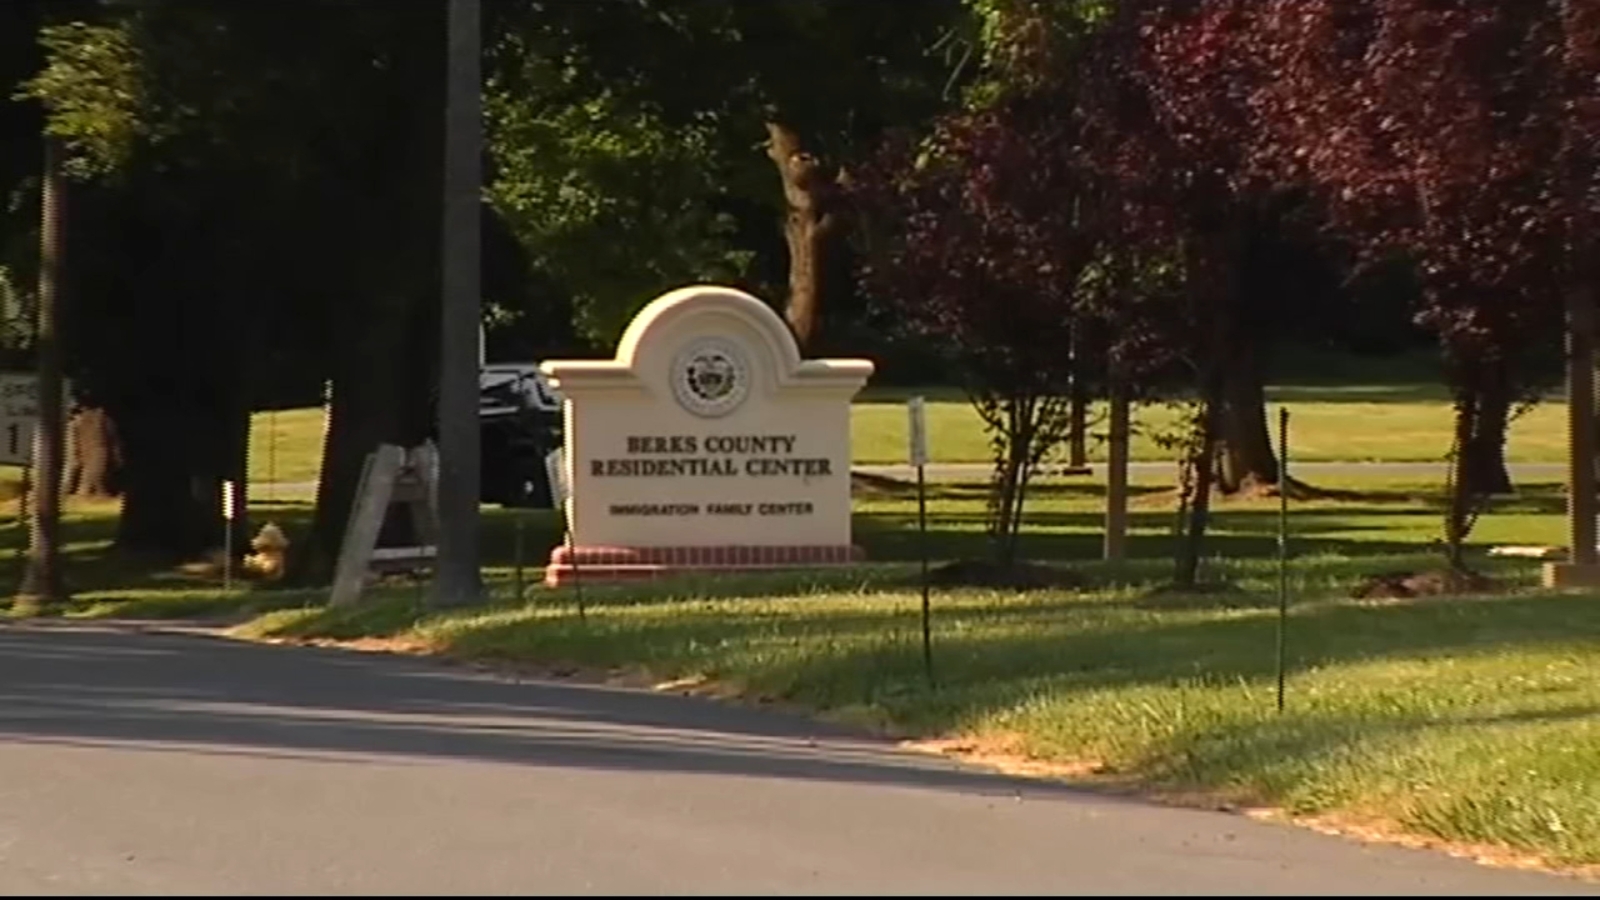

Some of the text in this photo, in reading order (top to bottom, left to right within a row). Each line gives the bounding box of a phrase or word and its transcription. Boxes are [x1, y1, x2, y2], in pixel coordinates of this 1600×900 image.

[626, 435, 796, 454] BERKS COUNTY
[591, 458, 832, 477] RESIDENTIAL CENTER
[609, 502, 813, 516] IMMIGRATION FAMILY CENTER
